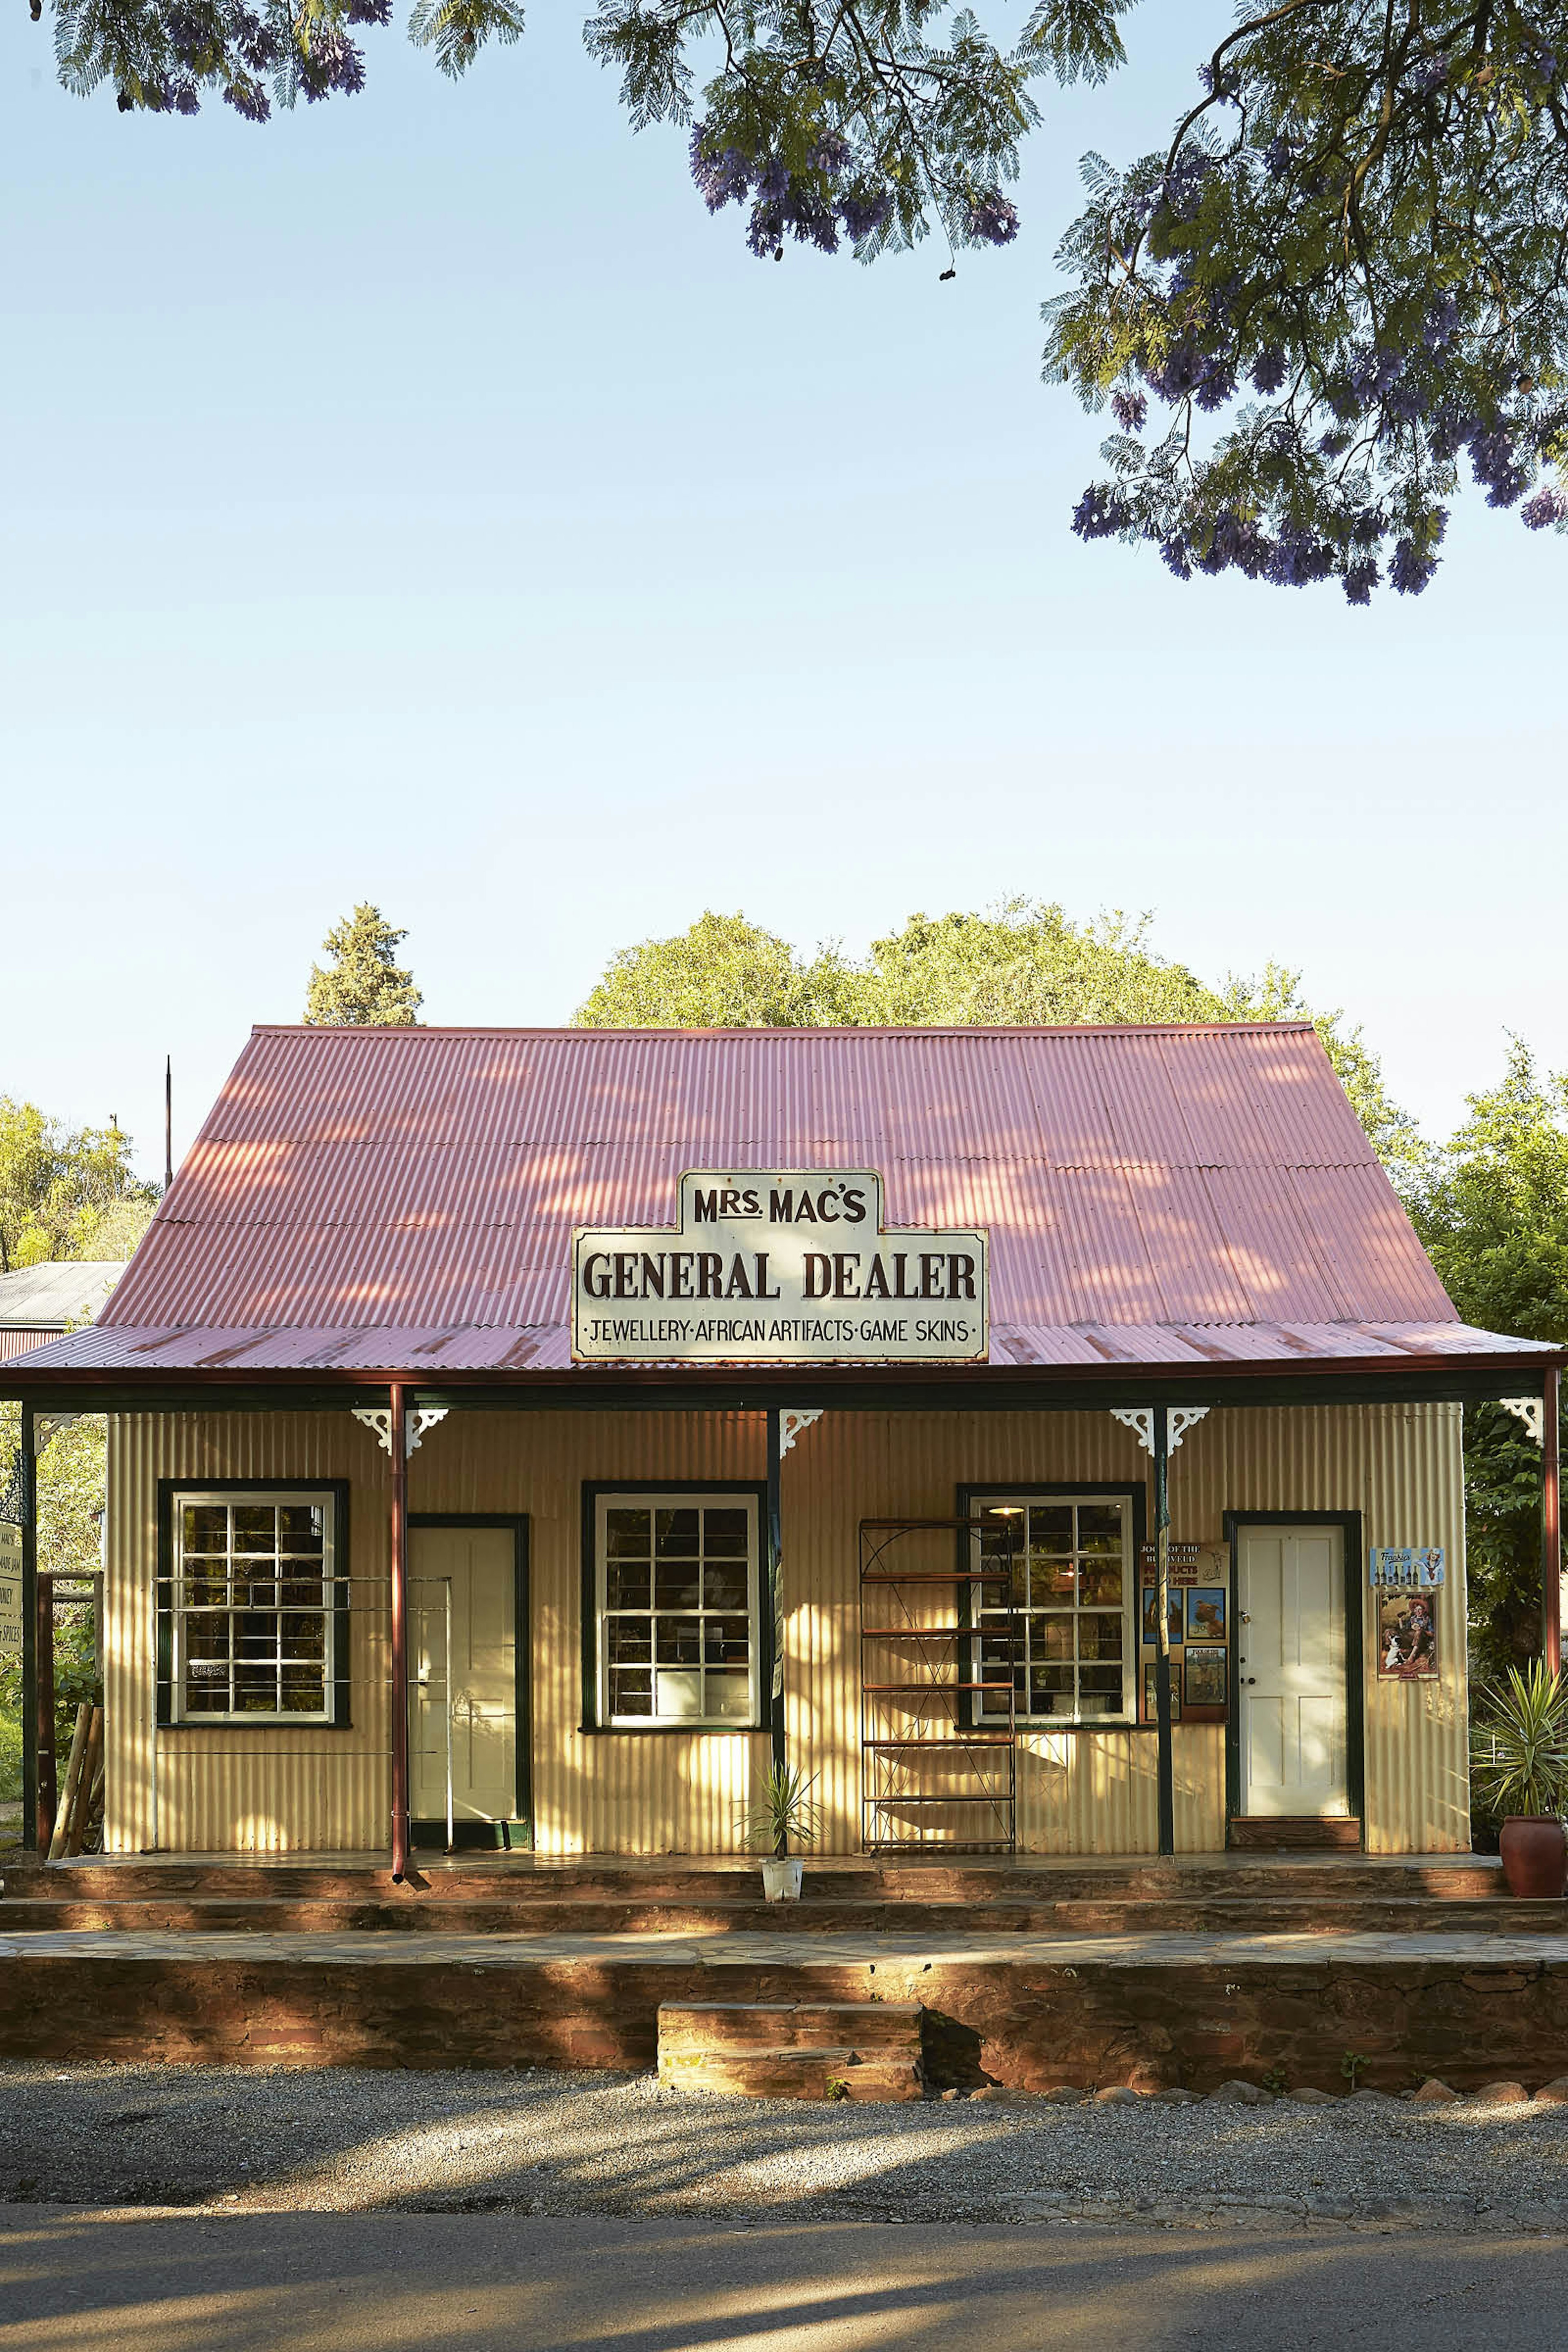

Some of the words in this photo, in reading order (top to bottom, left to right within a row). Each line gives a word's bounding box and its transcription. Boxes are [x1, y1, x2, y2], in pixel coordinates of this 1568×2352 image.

[695, 1189, 763, 1222] MRS.
[770, 1183, 866, 1223] MAC'S
[583, 1252, 781, 1299] GENERAL
[802, 1253, 976, 1300] DEALER
[590, 1319, 691, 1341] JEWELLERY
[695, 1319, 765, 1341] AFRICAN
[768, 1319, 854, 1341] ARTIFACTS
[860, 1319, 908, 1341] GAME
[915, 1319, 969, 1342] SKINS
